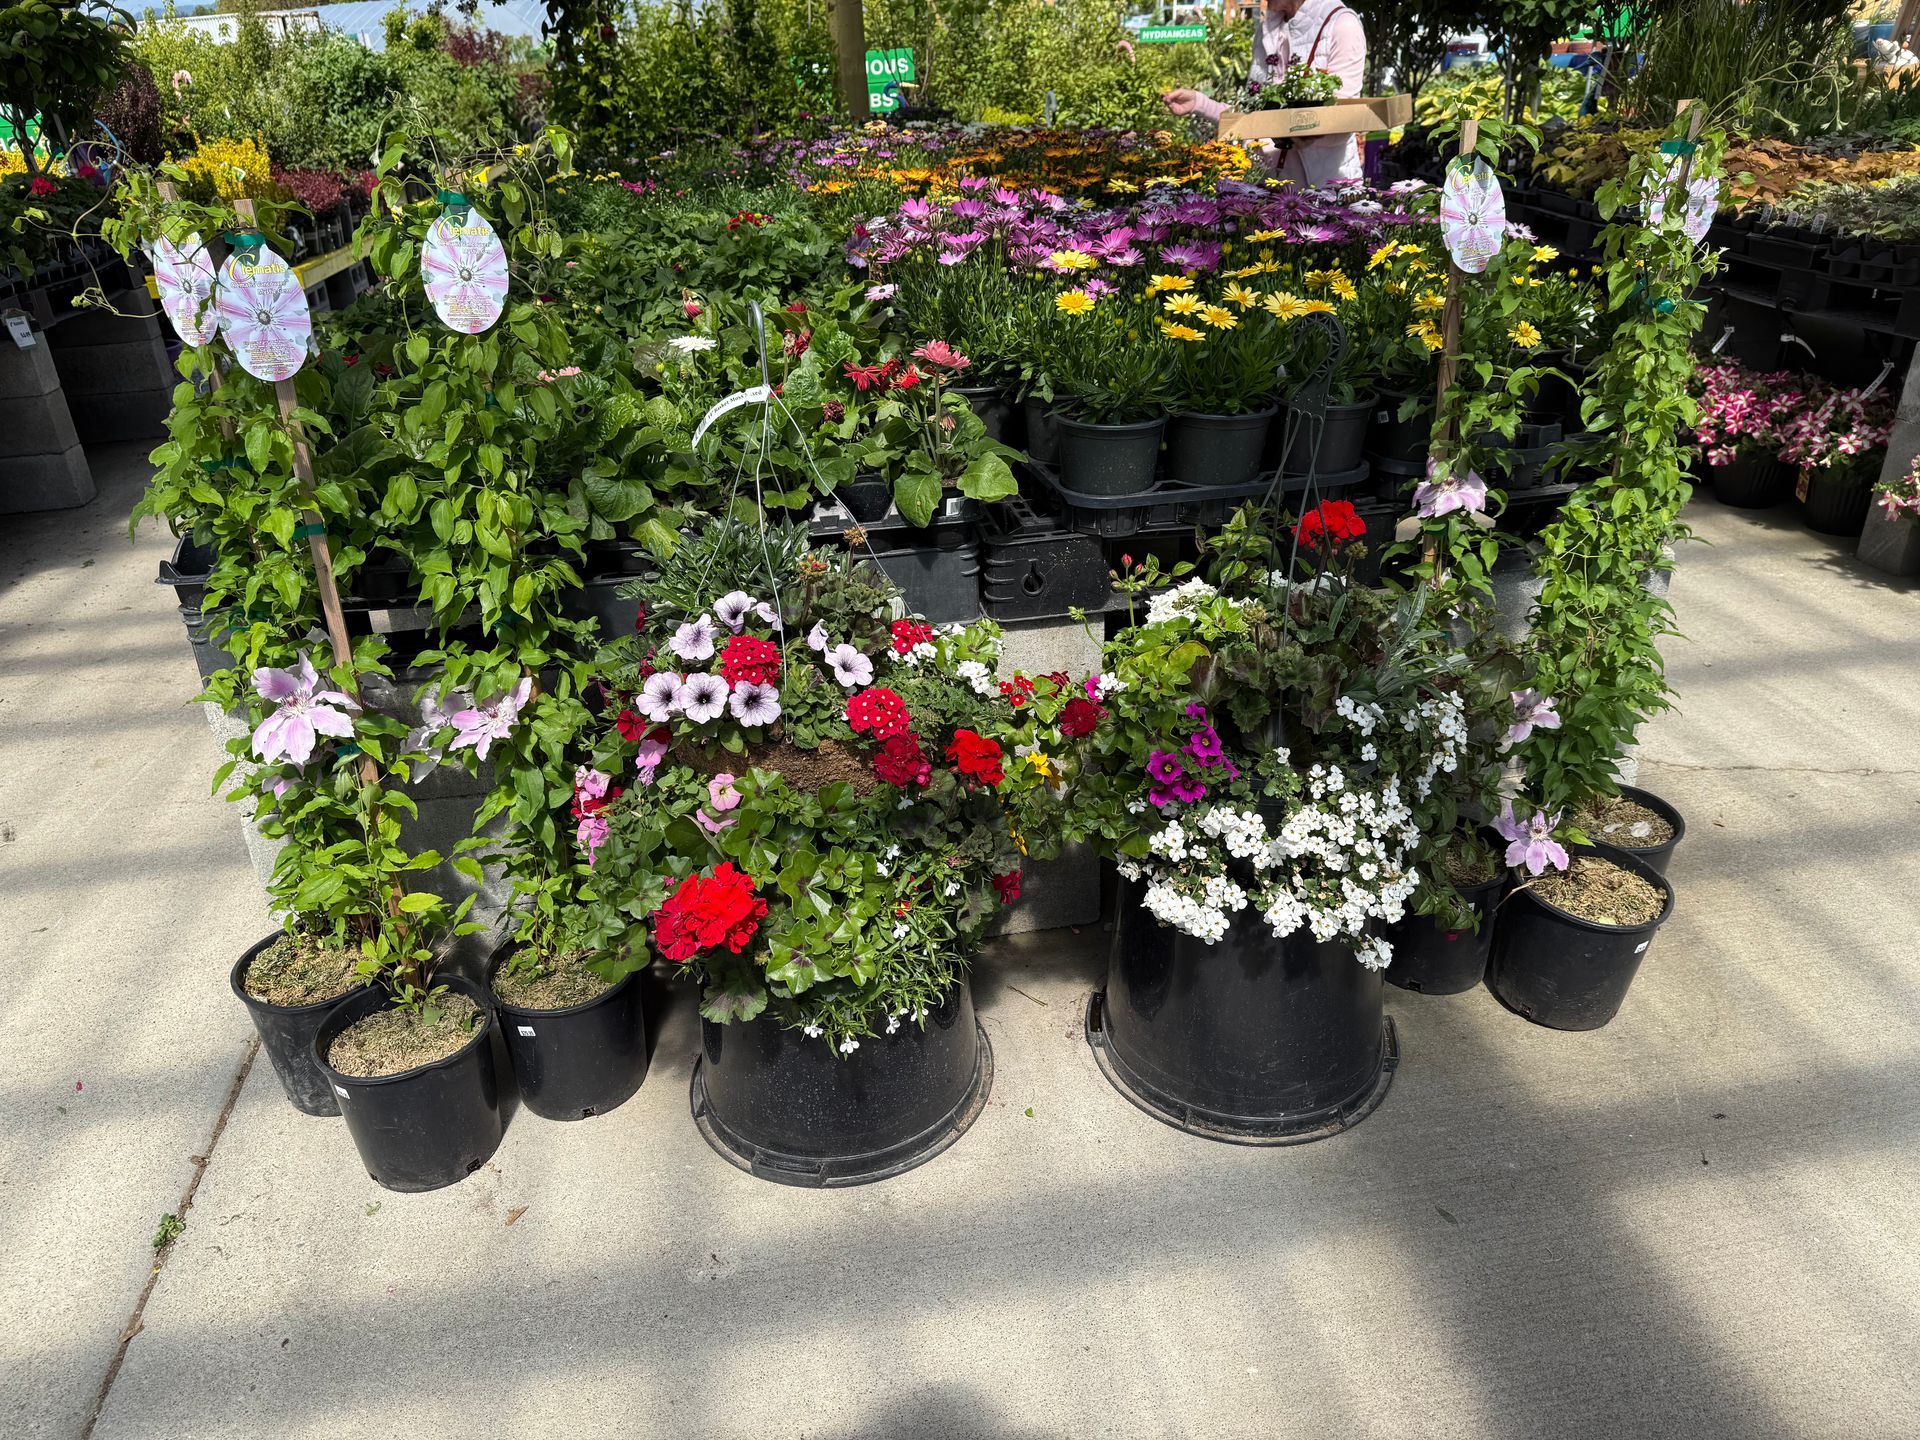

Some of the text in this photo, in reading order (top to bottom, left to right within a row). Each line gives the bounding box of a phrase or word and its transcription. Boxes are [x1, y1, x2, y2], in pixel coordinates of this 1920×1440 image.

[1142, 29, 1203, 40] HYDRANGEAS
[437, 215, 490, 241] Clematis
[229, 253, 287, 281] Clematis
